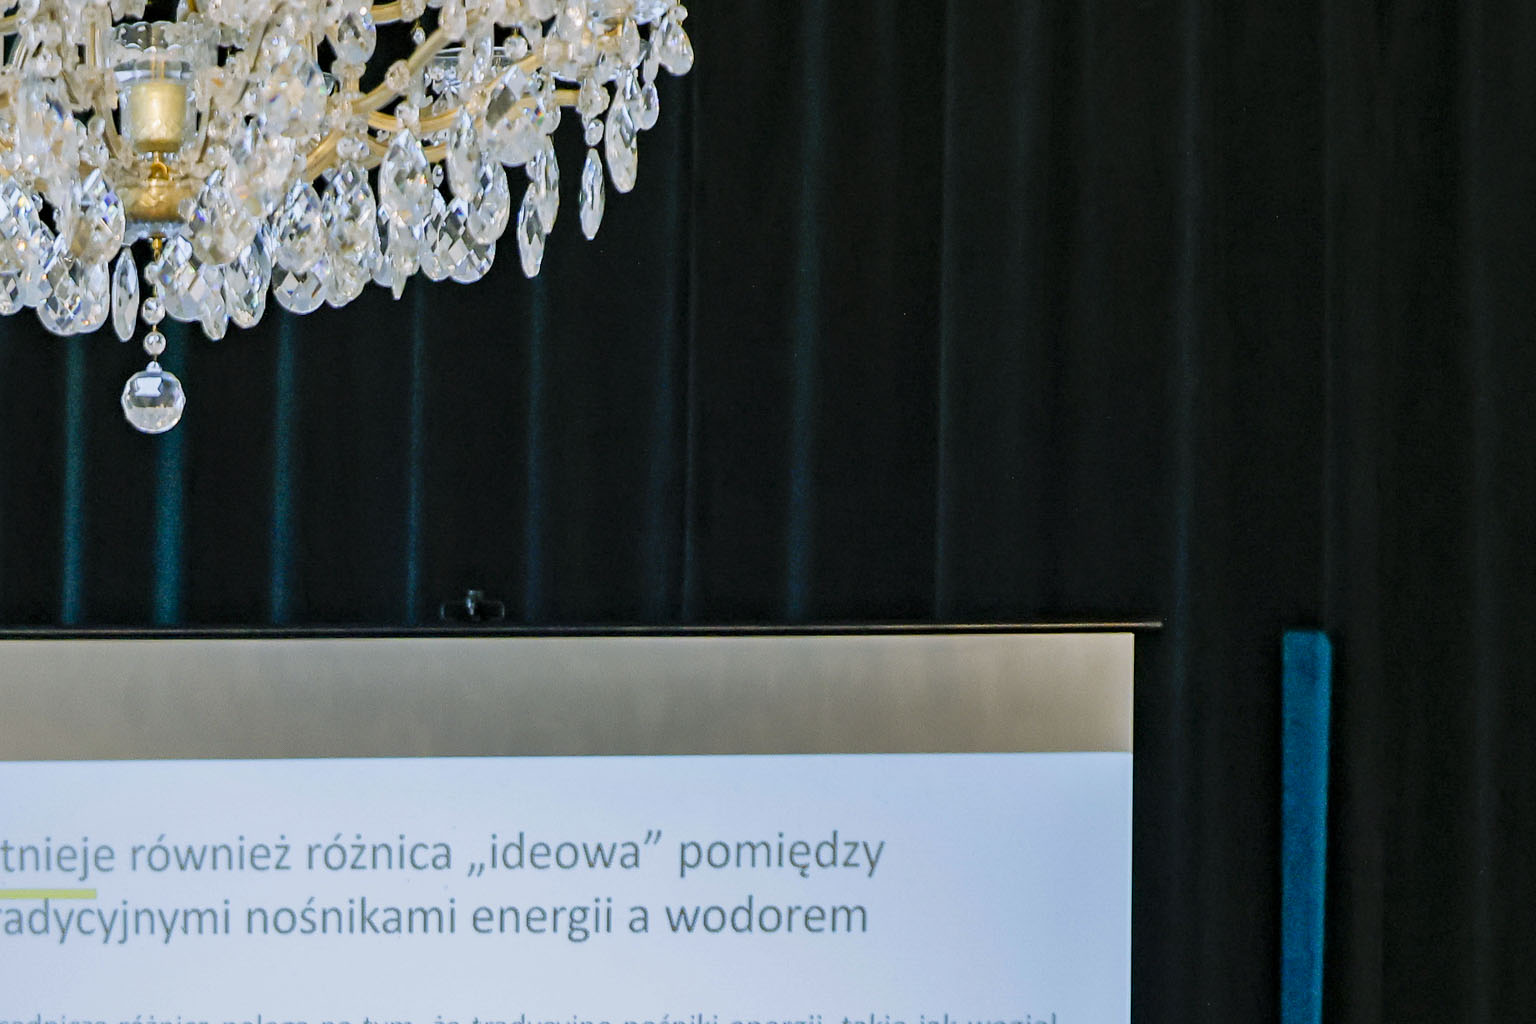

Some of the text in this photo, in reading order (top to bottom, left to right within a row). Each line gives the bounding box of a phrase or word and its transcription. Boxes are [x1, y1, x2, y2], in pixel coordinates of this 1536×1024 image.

[131, 834, 291, 872] również
[308, 833, 451, 871] różnica
[468, 830, 662, 877] „ideowa”
[680, 830, 885, 879] pomiędzy
[247, 896, 455, 935] nośnikami
[472, 897, 612, 943] energii
[629, 906, 648, 933] a
[665, 894, 867, 933] wodorem
